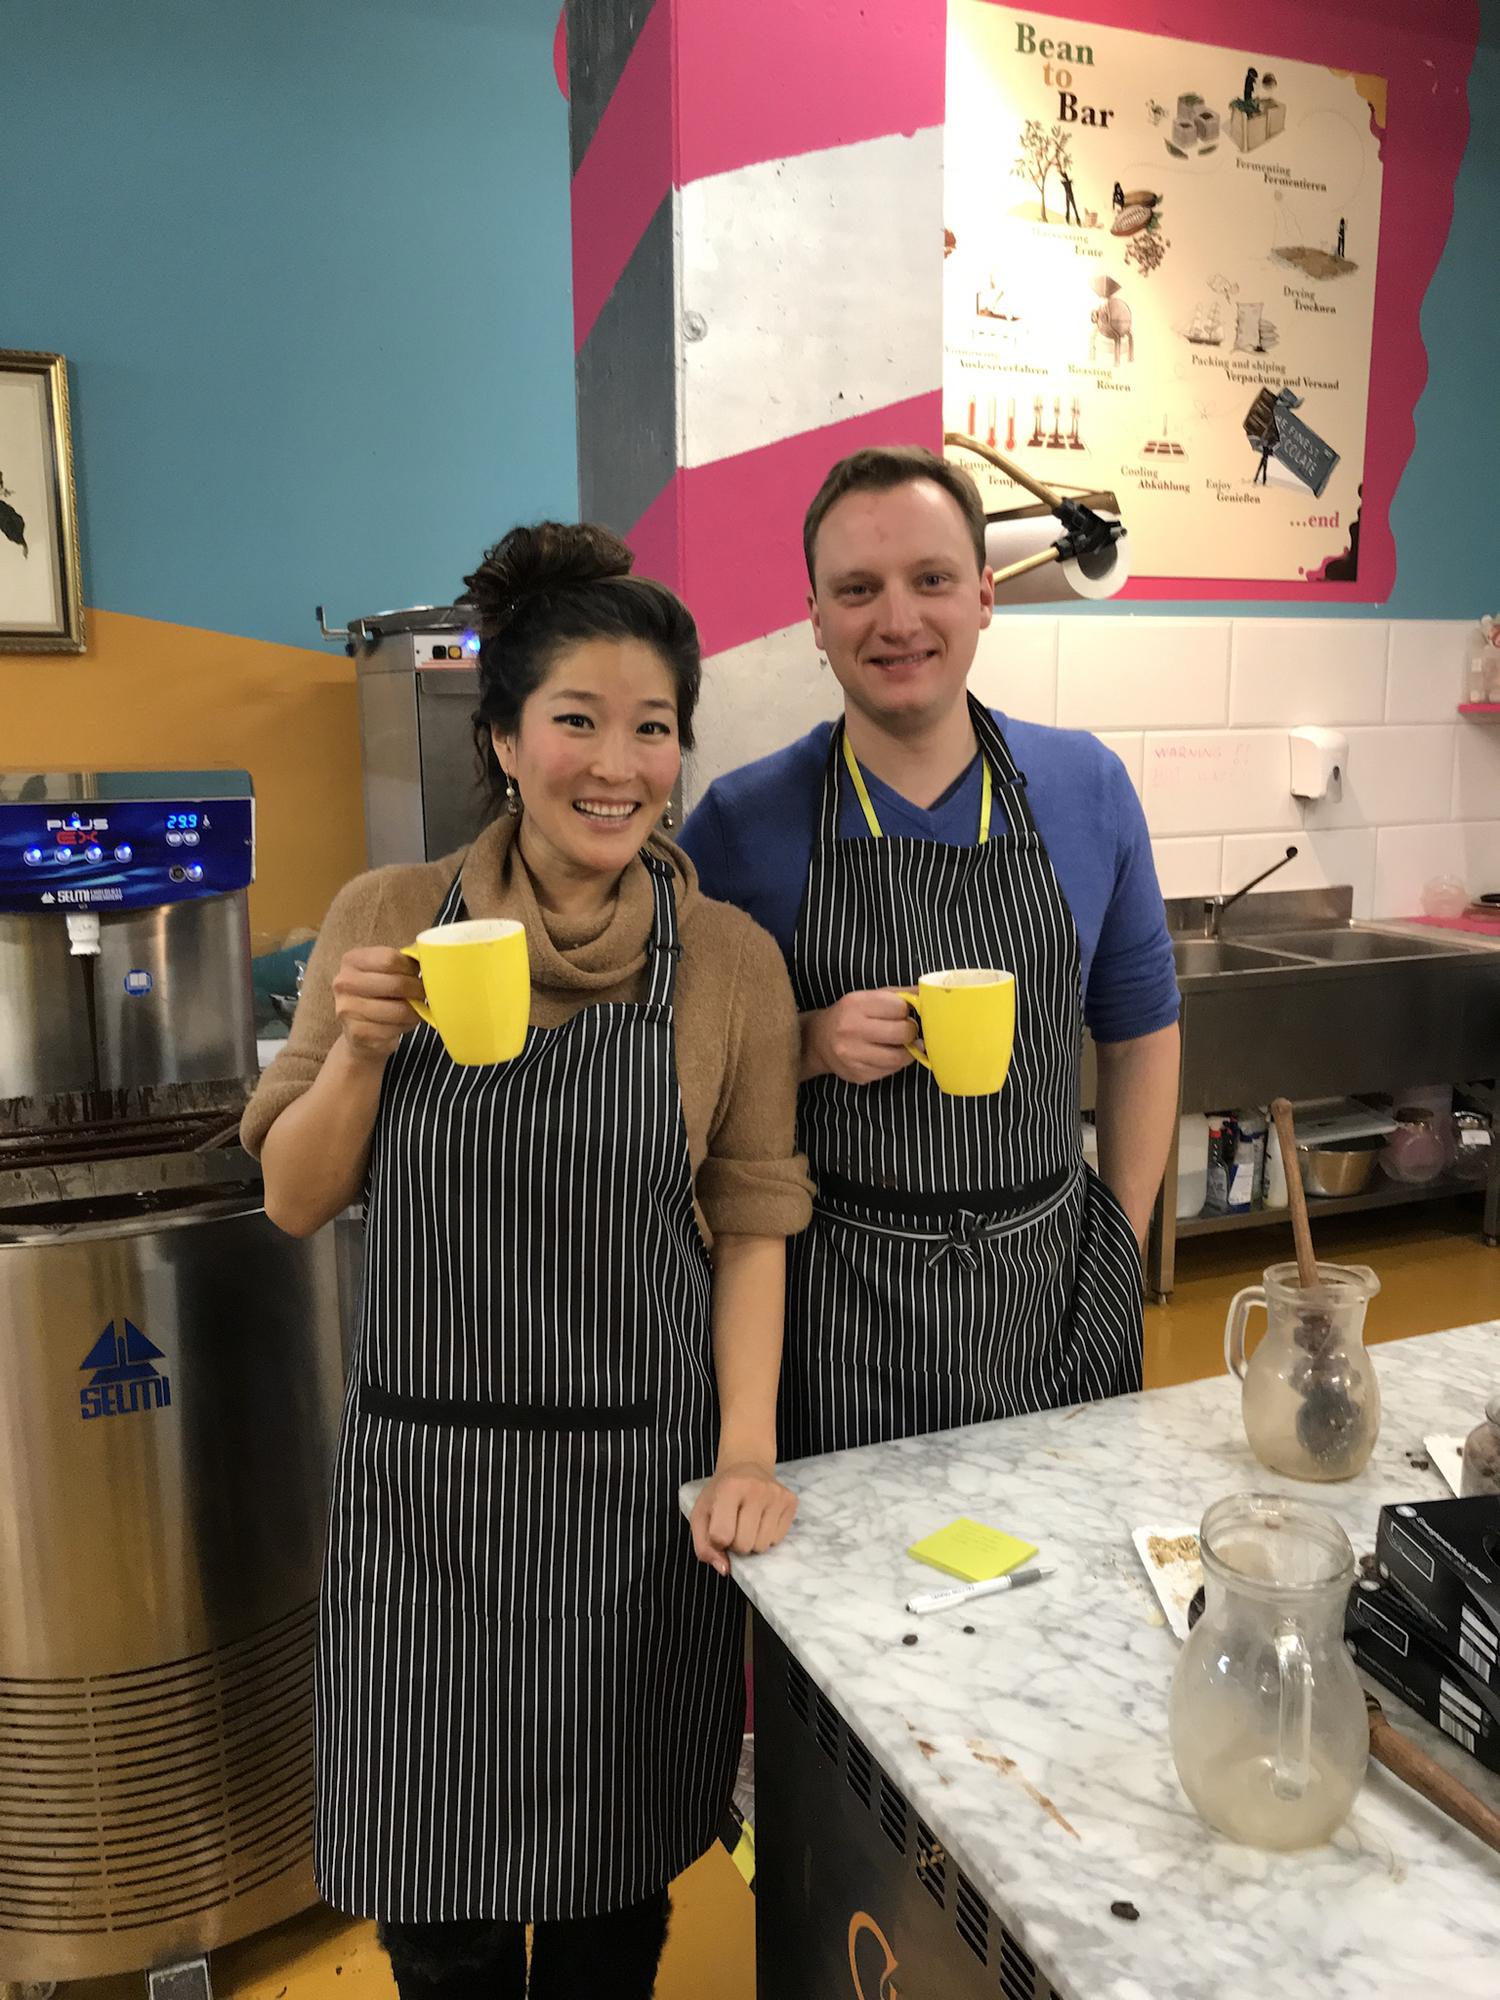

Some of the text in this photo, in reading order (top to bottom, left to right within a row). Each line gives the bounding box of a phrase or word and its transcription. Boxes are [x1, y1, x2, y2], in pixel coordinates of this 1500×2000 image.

[1015, 21, 1095, 66] Bean
[1043, 61, 1073, 89] to
[1057, 90, 1115, 129] Bar
[1235, 157, 1291, 177] Fermenting
[1264, 172, 1328, 192] Fermentieren
[1283, 285, 1316, 302] Drying
[1294, 298, 1337, 314] Trocknen
[1067, 364, 1113, 379] Roasting
[1191, 354, 1287, 375] Packing and shiping
[1225, 370, 1340, 391] Verpackung und Versand
[1120, 465, 1159, 480] Cooling
[1138, 479, 1191, 494] Abkühlung
[1205, 478, 1232, 494] Enjoy
[1216, 491, 1261, 505] Genießen
[47, 818, 109, 831] PLUS
[57, 889, 91, 903] SELMI
[79, 1376, 172, 1420] SELMI
